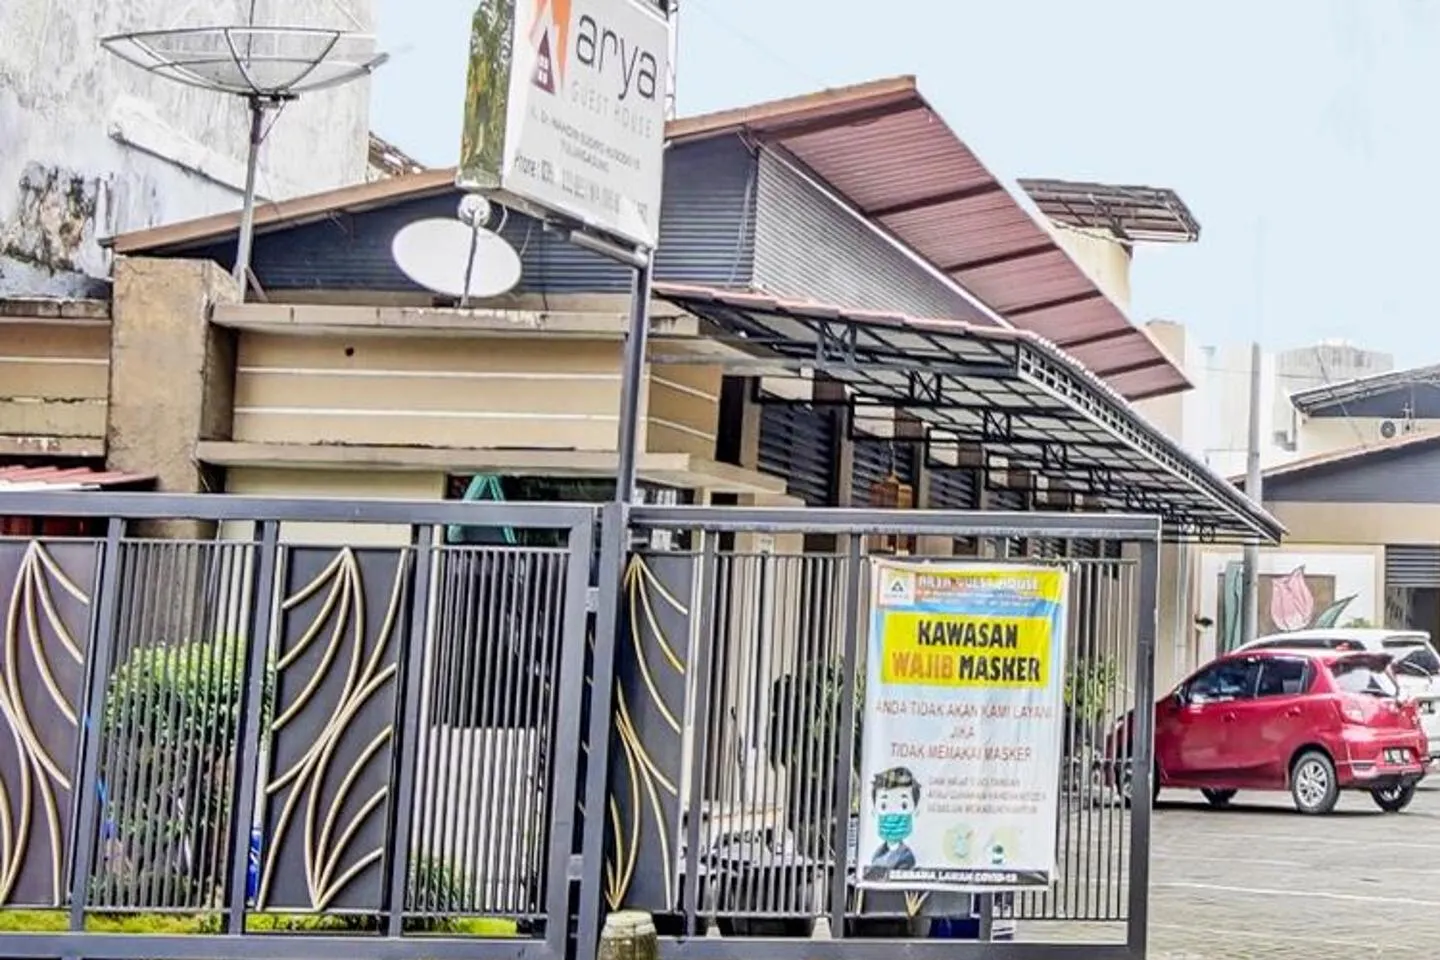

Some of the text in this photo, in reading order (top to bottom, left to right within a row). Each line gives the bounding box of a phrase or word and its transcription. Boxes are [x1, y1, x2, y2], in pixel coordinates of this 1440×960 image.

[575, 14, 658, 101] arya
[917, 619, 1018, 649] KAWASAN
[892, 651, 1040, 682] WAJIB MASKER
[876, 701, 907, 716] ANDA
[910, 701, 943, 717] TIDAK
[947, 703, 979, 718] AKAN
[981, 703, 1011, 719] KAMI
[891, 742, 1031, 762] TIDAK MEMAKAI MASKER
